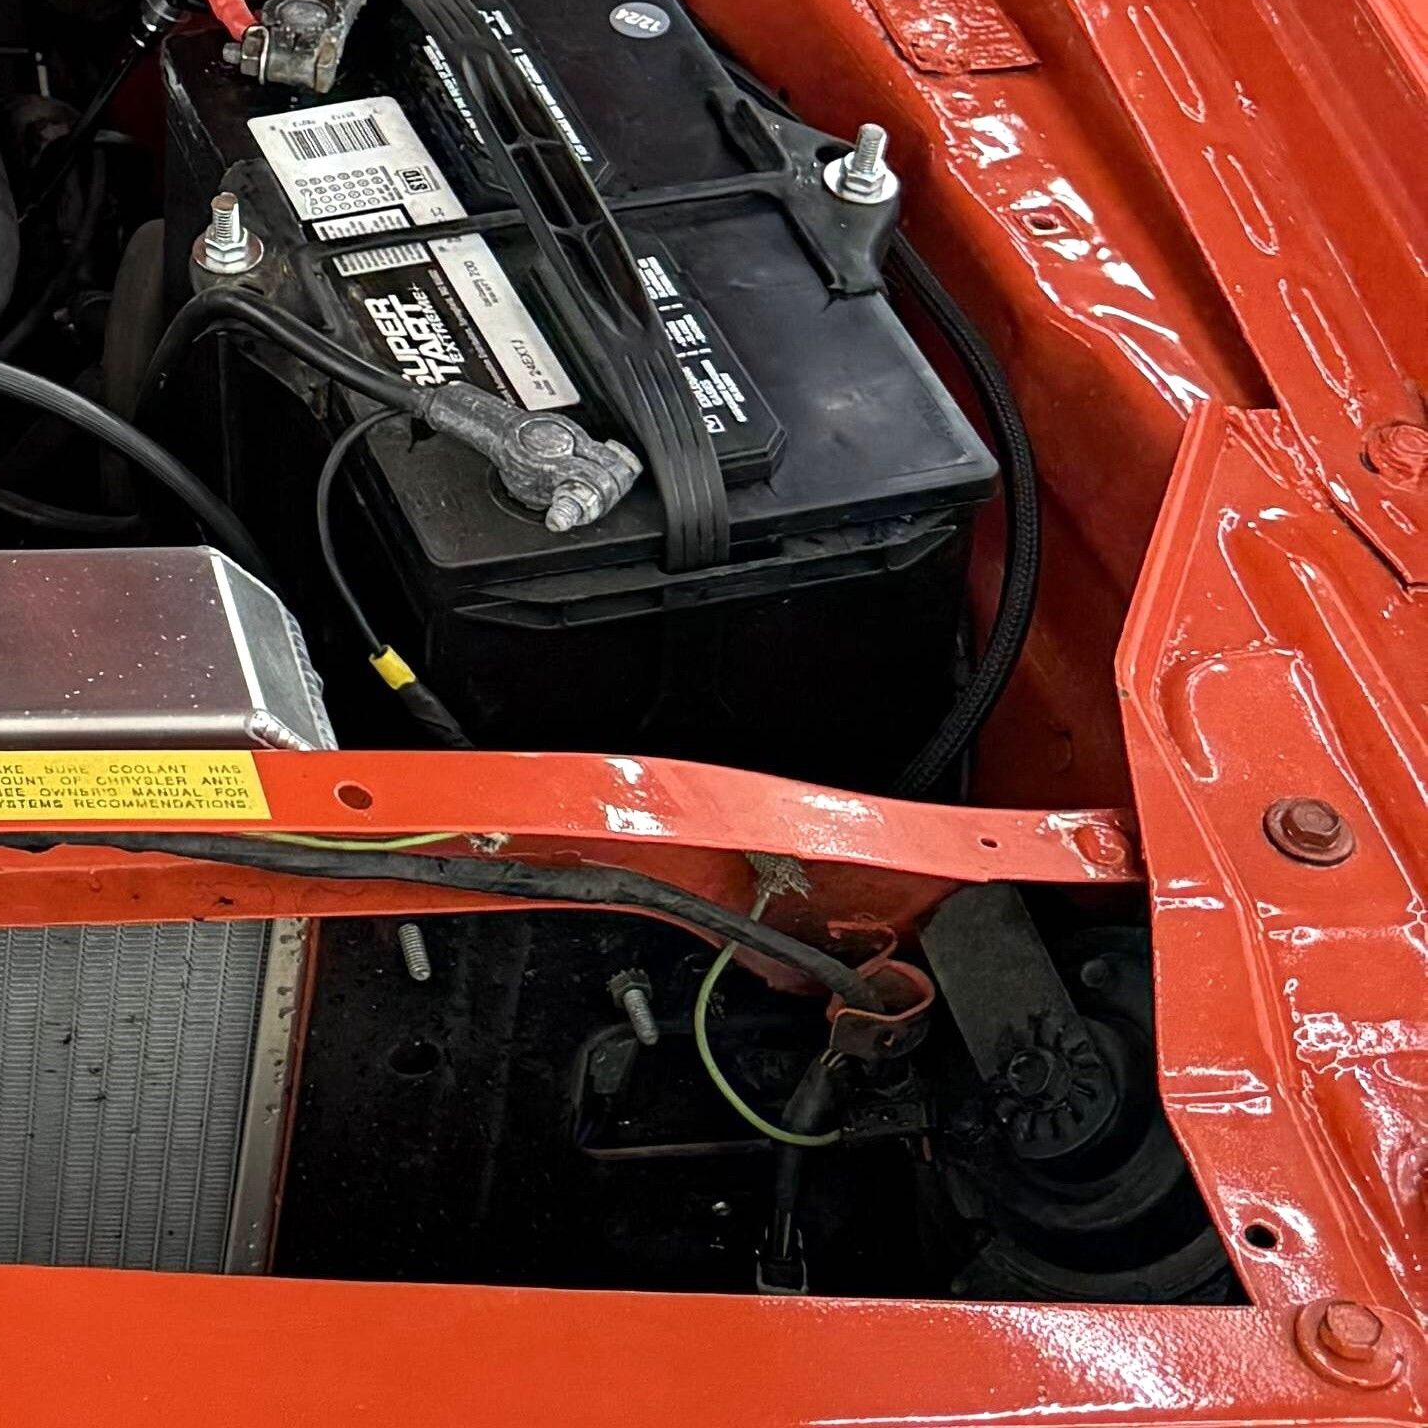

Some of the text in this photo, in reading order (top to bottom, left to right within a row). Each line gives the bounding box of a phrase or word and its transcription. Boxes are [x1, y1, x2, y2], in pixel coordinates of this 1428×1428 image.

[615, 8, 662, 32] 12/24
[388, 294, 462, 386] TART
[43, 763, 90, 775] SURE
[108, 763, 188, 775] COOLANT
[208, 763, 242, 775] HAS
[59, 775, 80, 787] OF
[95, 775, 188, 787] CHRYSLER
[39, 787, 118, 798] OWNER'S
[131, 787, 203, 798] MANUAL
[214, 786, 249, 799] FOR
